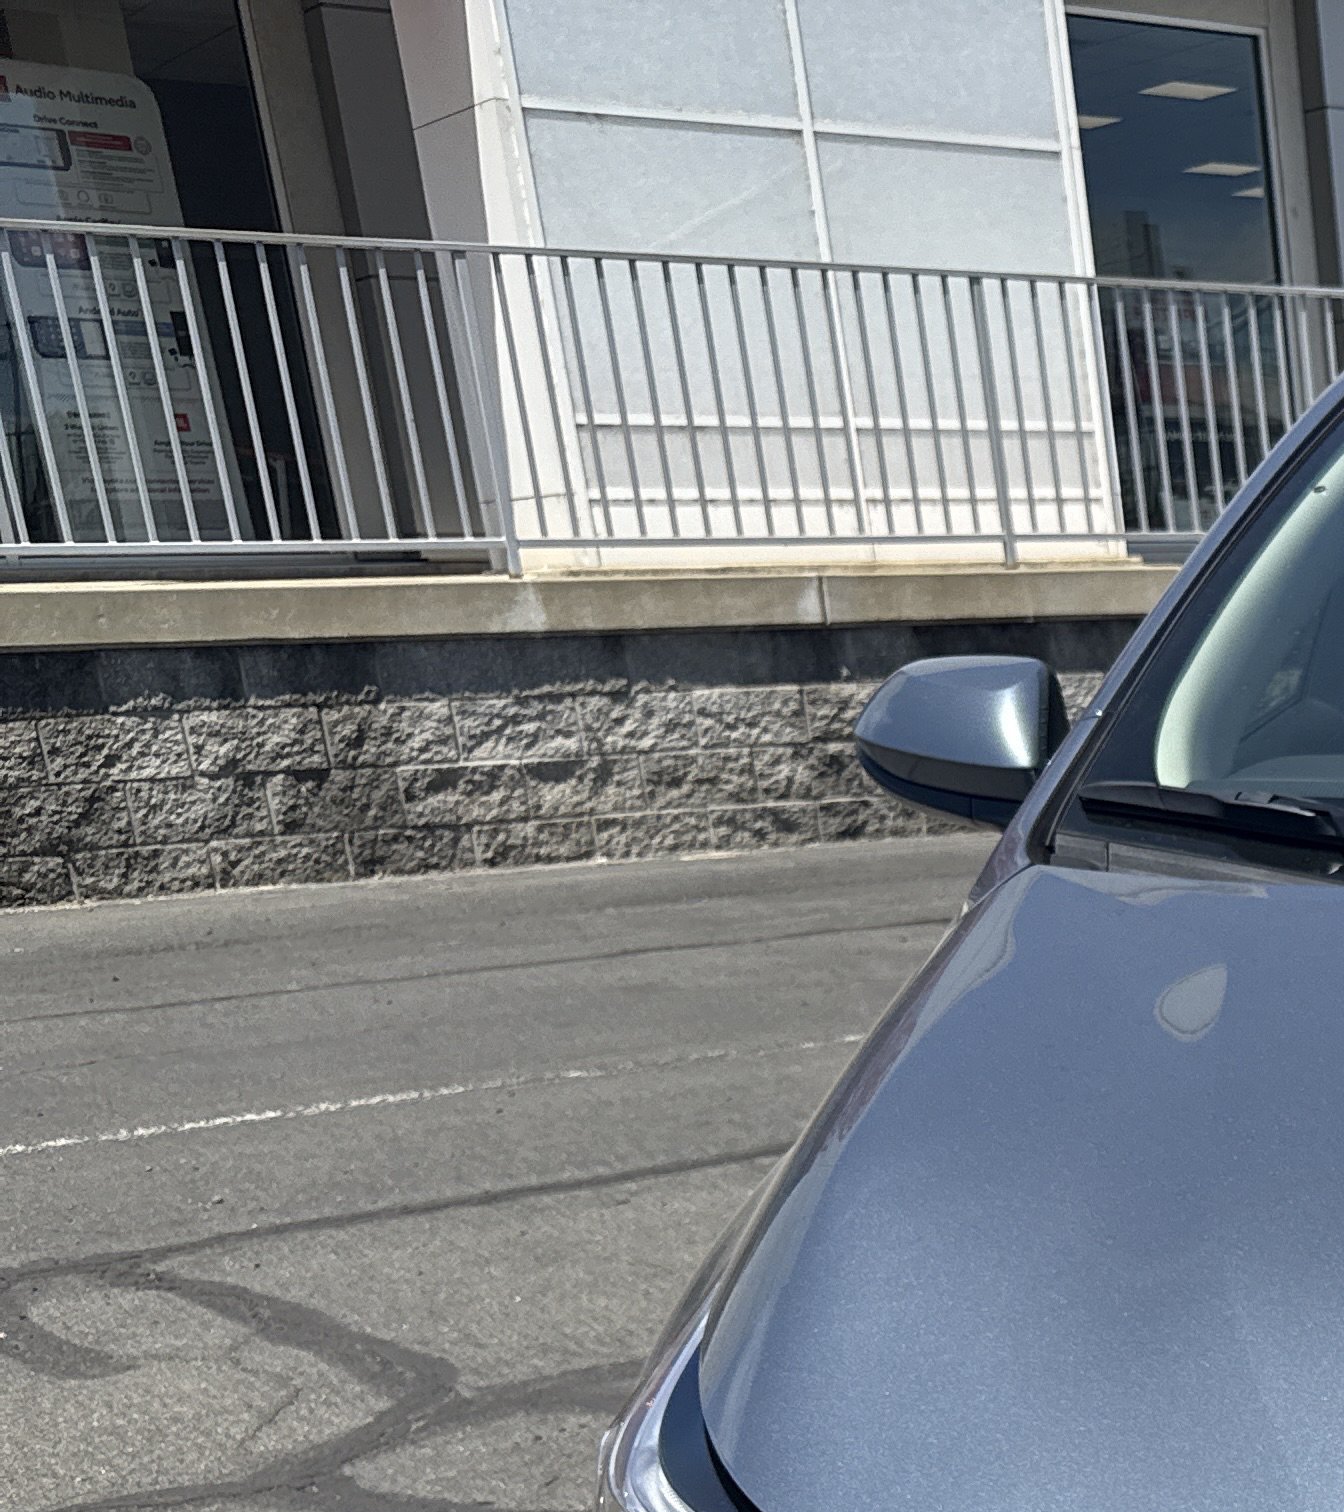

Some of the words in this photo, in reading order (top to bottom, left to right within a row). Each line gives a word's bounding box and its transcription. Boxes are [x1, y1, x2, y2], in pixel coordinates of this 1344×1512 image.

[15, 84, 57, 101] Audio
[59, 89, 137, 109] Multimedia
[59, 117, 99, 129] Connect
